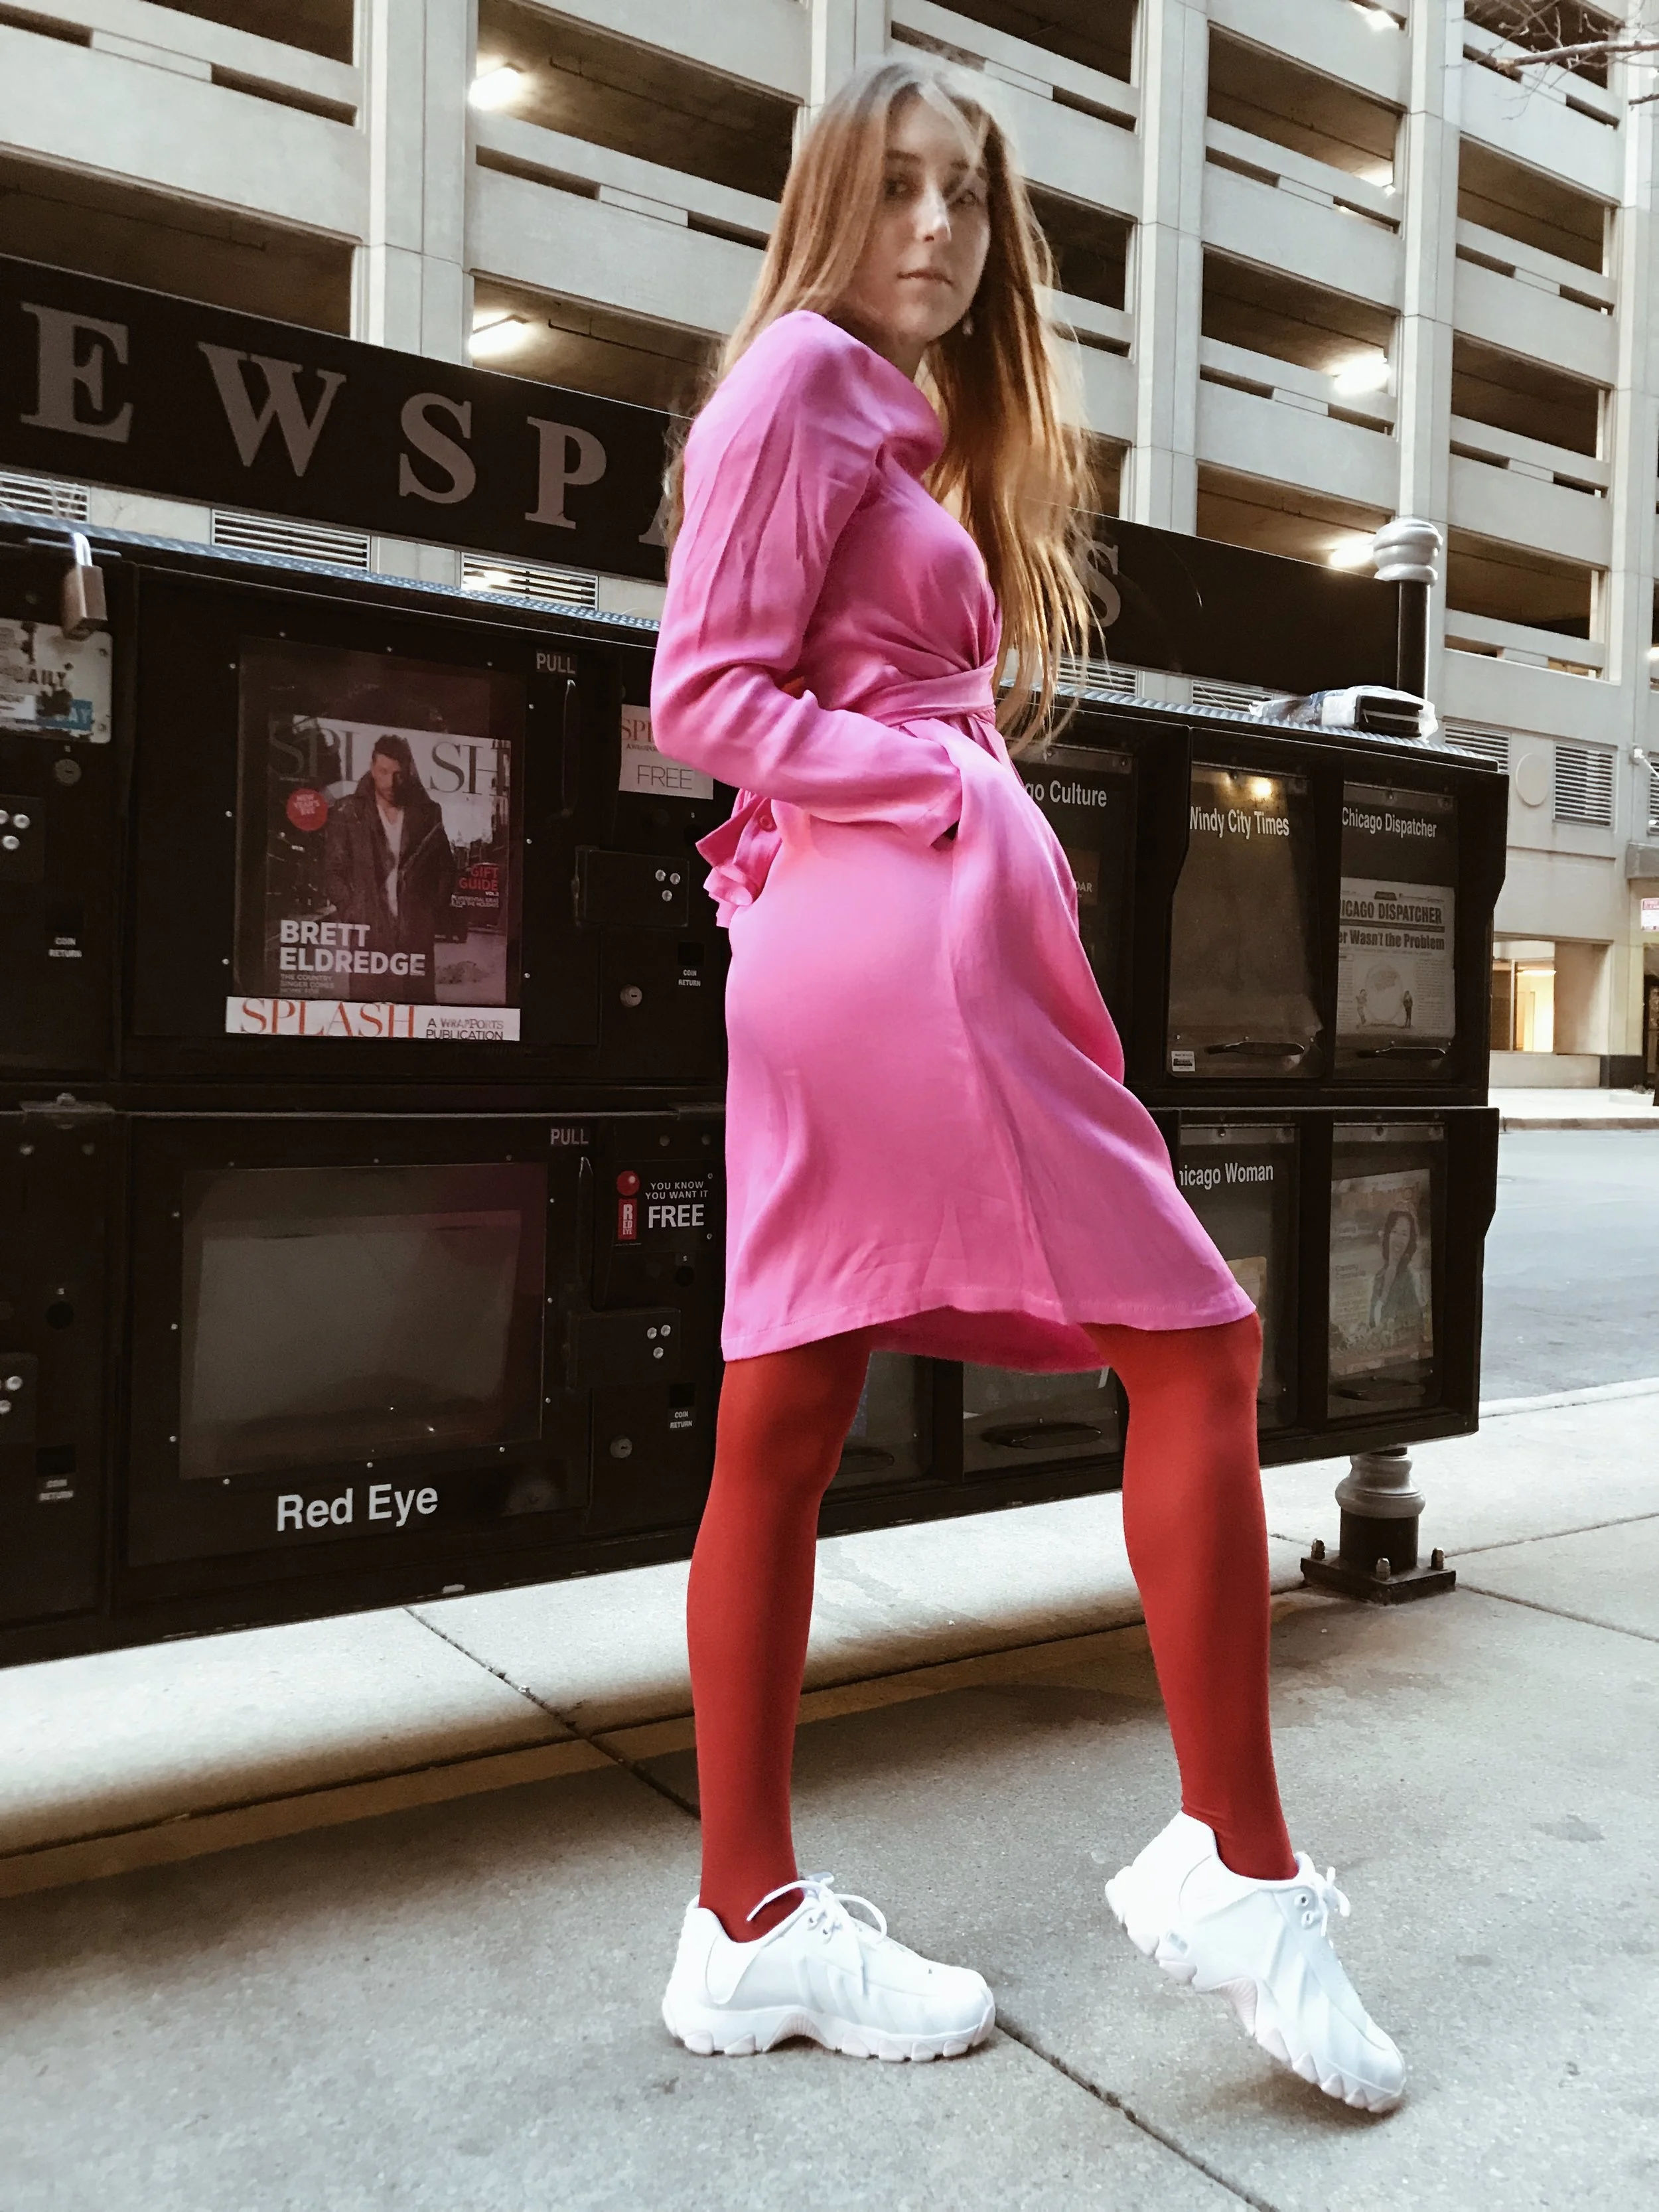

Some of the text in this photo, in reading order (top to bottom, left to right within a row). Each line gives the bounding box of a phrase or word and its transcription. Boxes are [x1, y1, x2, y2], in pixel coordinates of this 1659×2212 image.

[536, 652, 576, 675] PULL
[622, 719, 652, 742] SPL
[267, 718, 510, 798] SPLSH
[637, 765, 693, 790] FREE
[1049, 780, 1108, 808] Culture
[1228, 808, 1252, 840] City
[1254, 810, 1290, 836] Times
[1342, 806, 1437, 838] Chicago Dispatcher
[471, 865, 499, 878] GIFT
[459, 877, 499, 891] GUIDE
[1340, 900, 1442, 924] ICAGO DISPATCHER
[280, 919, 371, 947] BRETT
[1350, 929, 1383, 946] Wasn't
[1385, 932, 1402, 948] the
[1404, 933, 1445, 950] Problem
[279, 947, 426, 976] ELDREDGE
[241, 997, 416, 1039] SPLASH
[427, 1018, 437, 1027] A
[426, 1029, 504, 1040] PUBLICATION
[551, 1128, 589, 1145] PULL
[675, 1181, 704, 1189] KNOW
[1179, 1162, 1273, 1190] icago Woman
[670, 1191, 697, 1199] WANT
[648, 1203, 705, 1228] FREE
[277, 1483, 439, 1532] Red Eye
